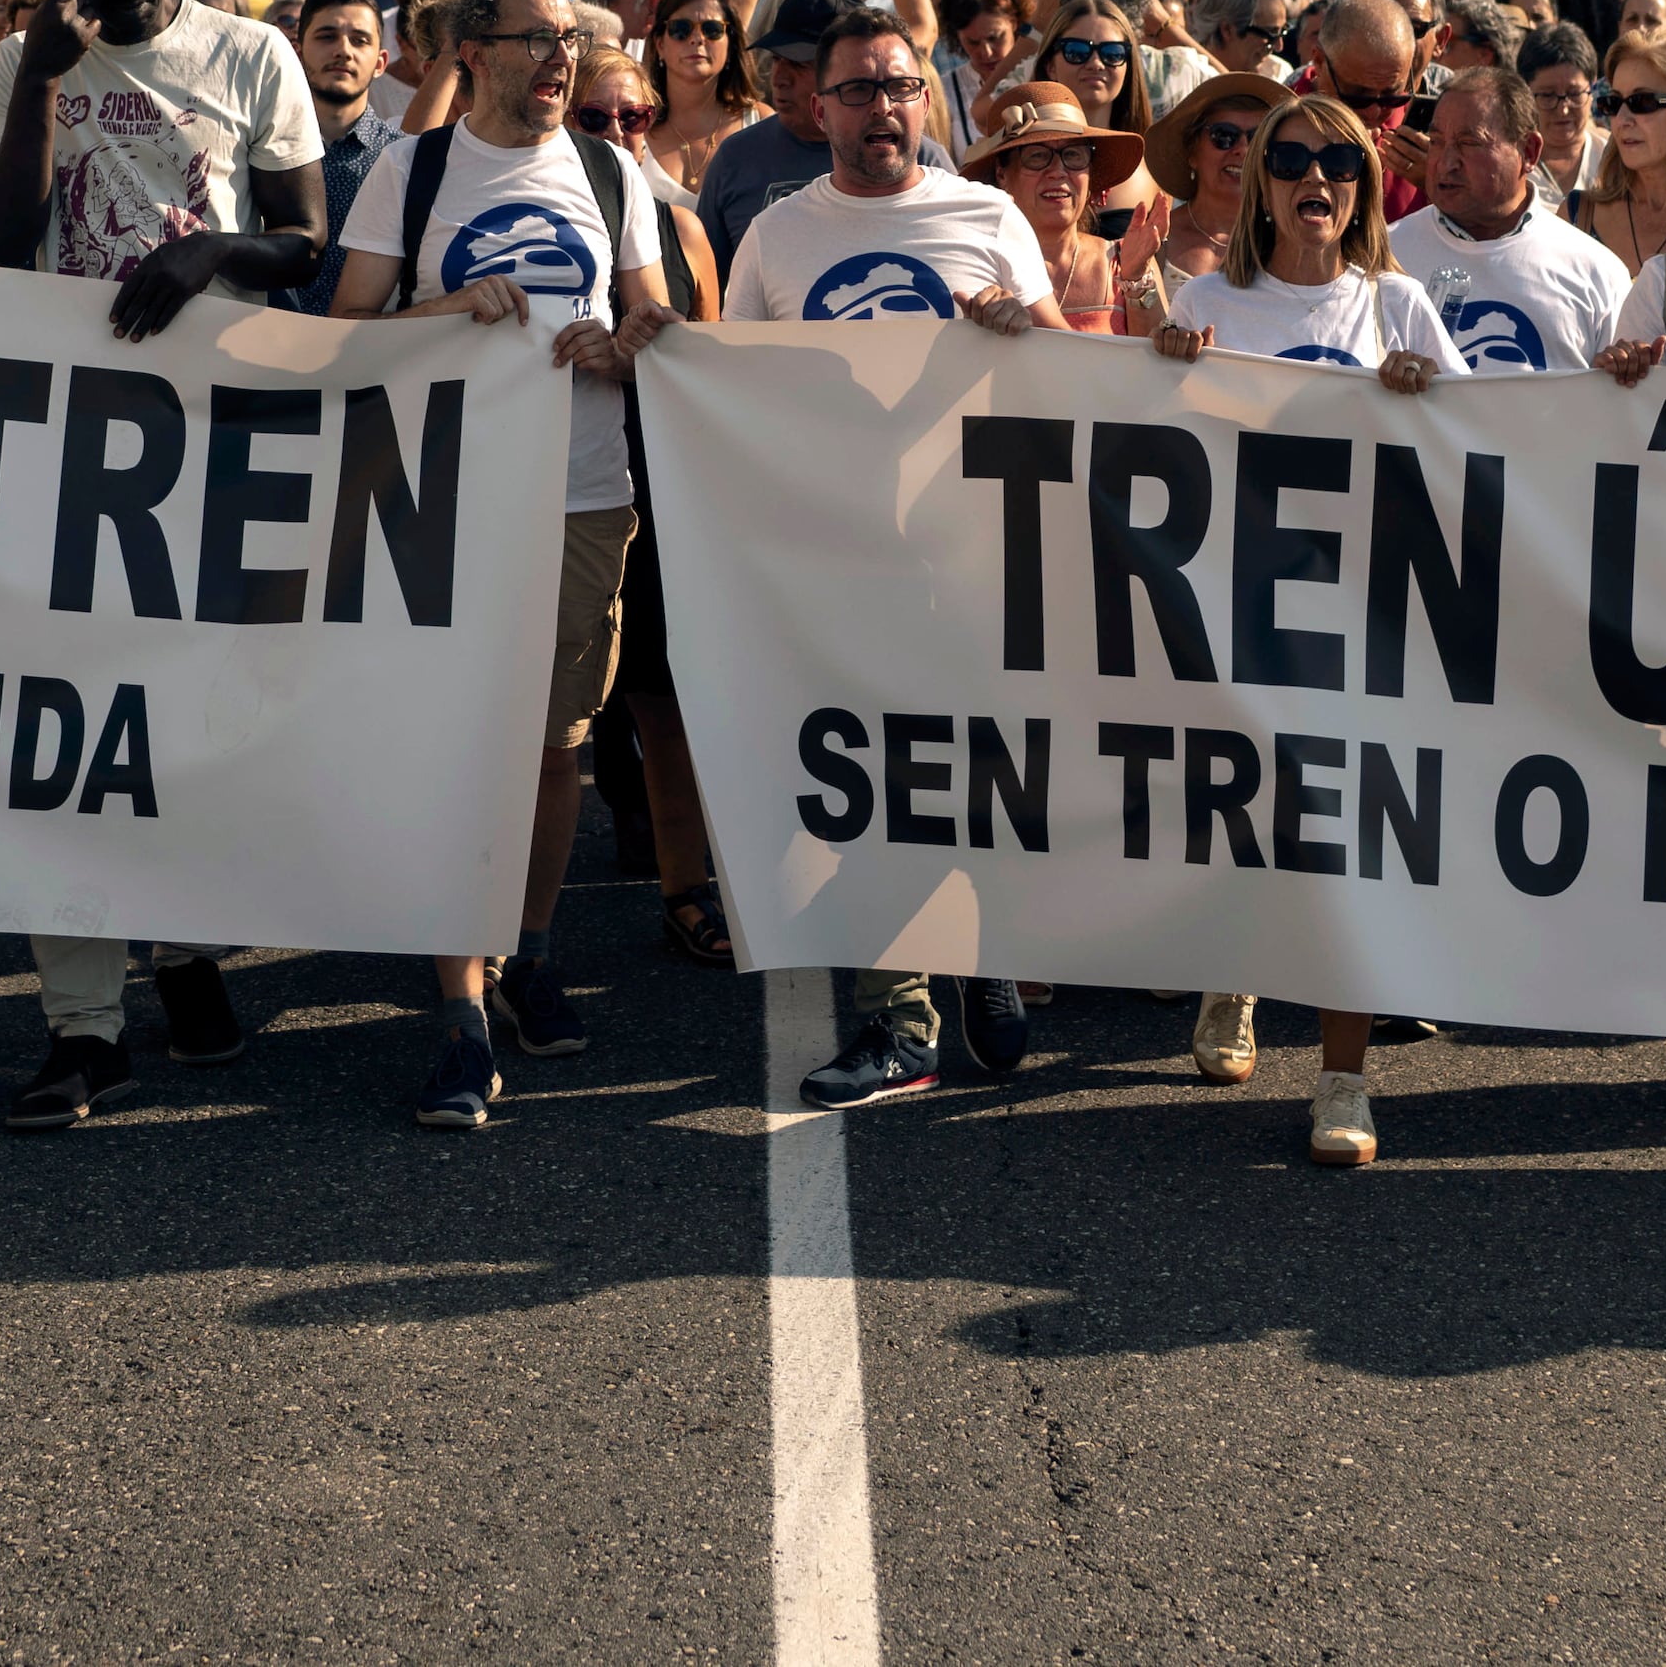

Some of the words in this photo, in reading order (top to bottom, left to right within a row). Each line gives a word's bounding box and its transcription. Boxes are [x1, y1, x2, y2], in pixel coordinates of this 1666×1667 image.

[97, 120, 127, 135] TRENDS
[135, 122, 162, 136] MUSIC
[98, 91, 161, 121] SIDERAL
[961, 415, 1505, 706] TREN
[796, 707, 1051, 853] SEN
[1098, 721, 1443, 886] TREN
[1494, 754, 1590, 897] O
